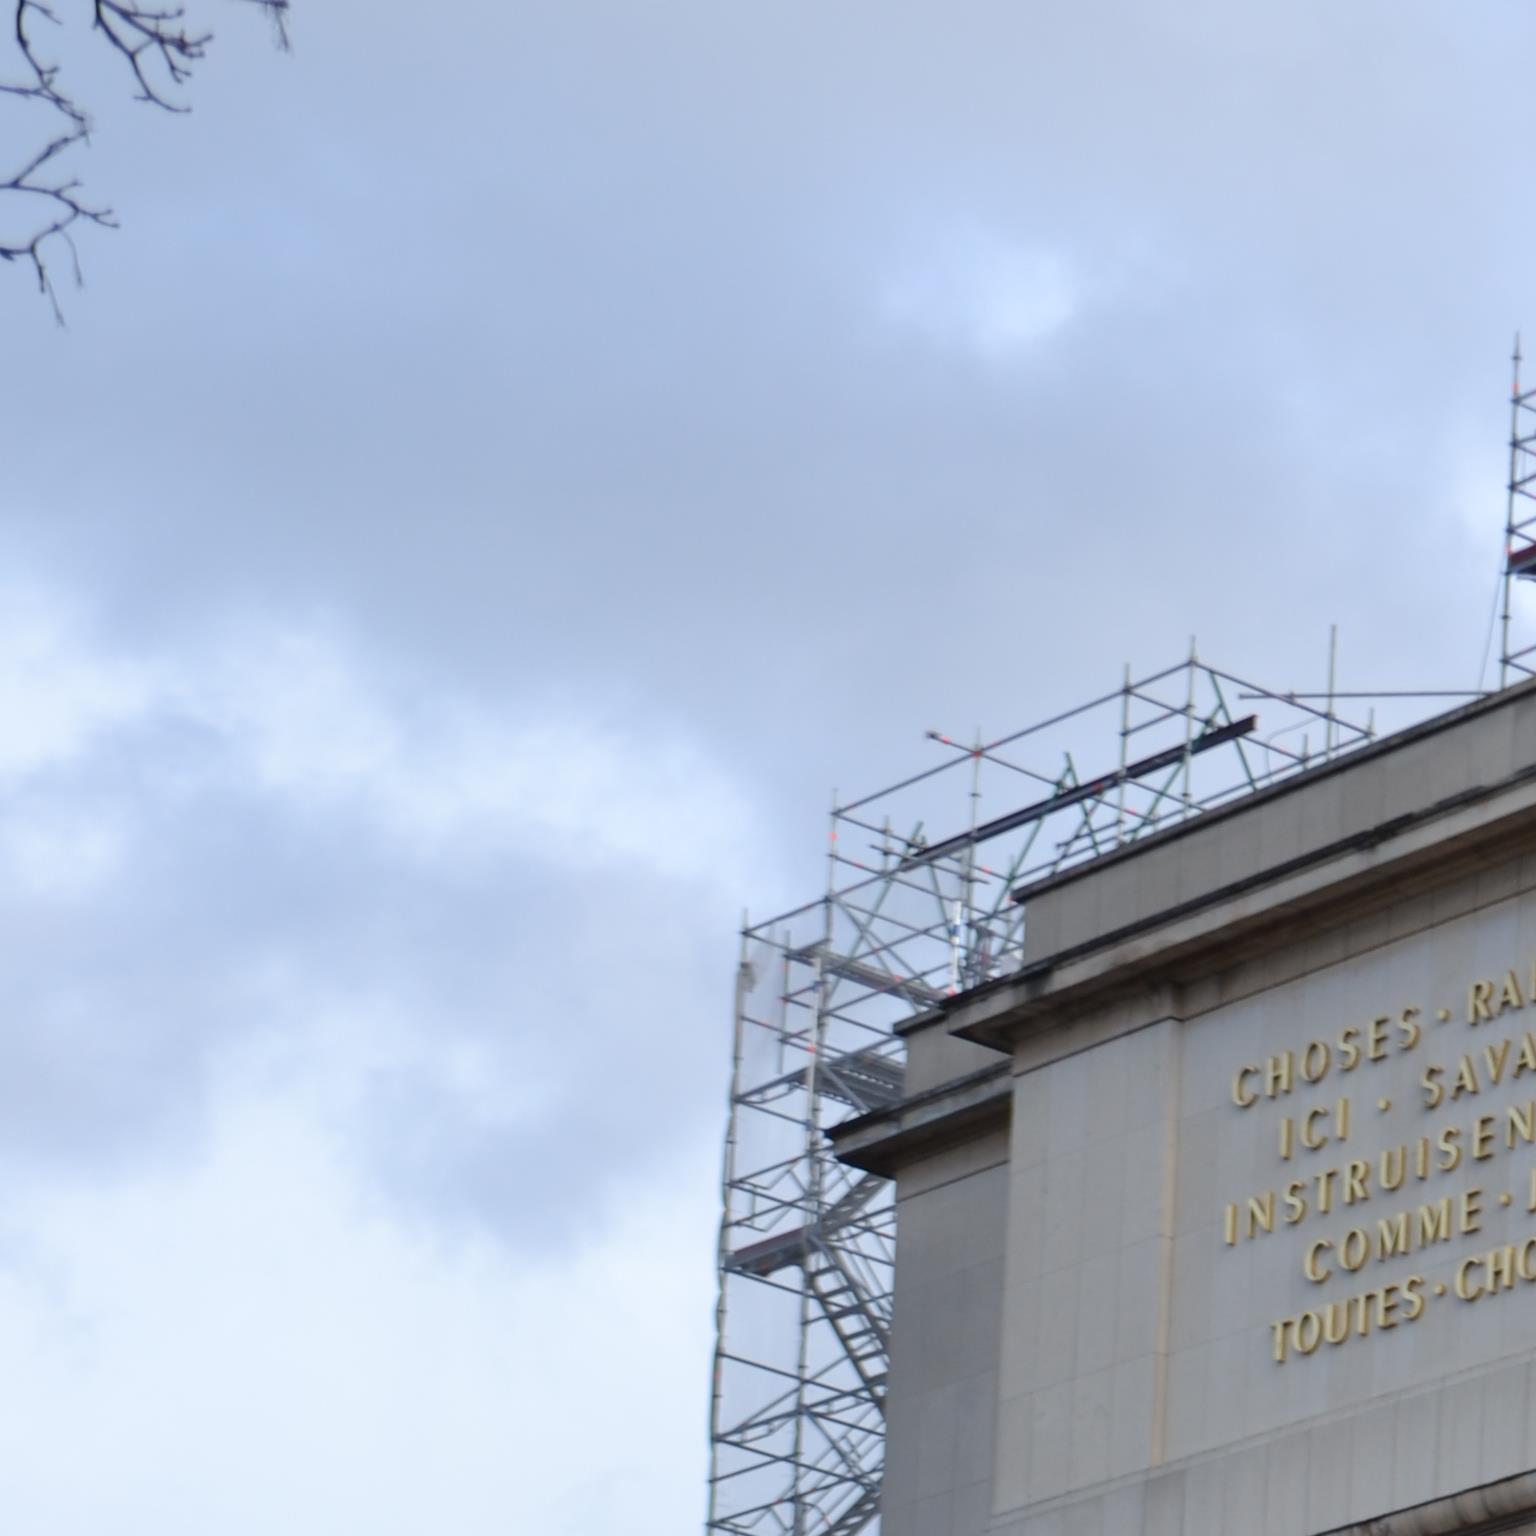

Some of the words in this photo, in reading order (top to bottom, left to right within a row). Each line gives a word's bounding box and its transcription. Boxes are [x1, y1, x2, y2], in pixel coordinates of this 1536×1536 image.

[1232, 1006, 1421, 1108] CHOSES
[1279, 1097, 1351, 1161] ICI
[1303, 1188, 1484, 1284] COMME
[1269, 1273, 1427, 1364] TOUTES
